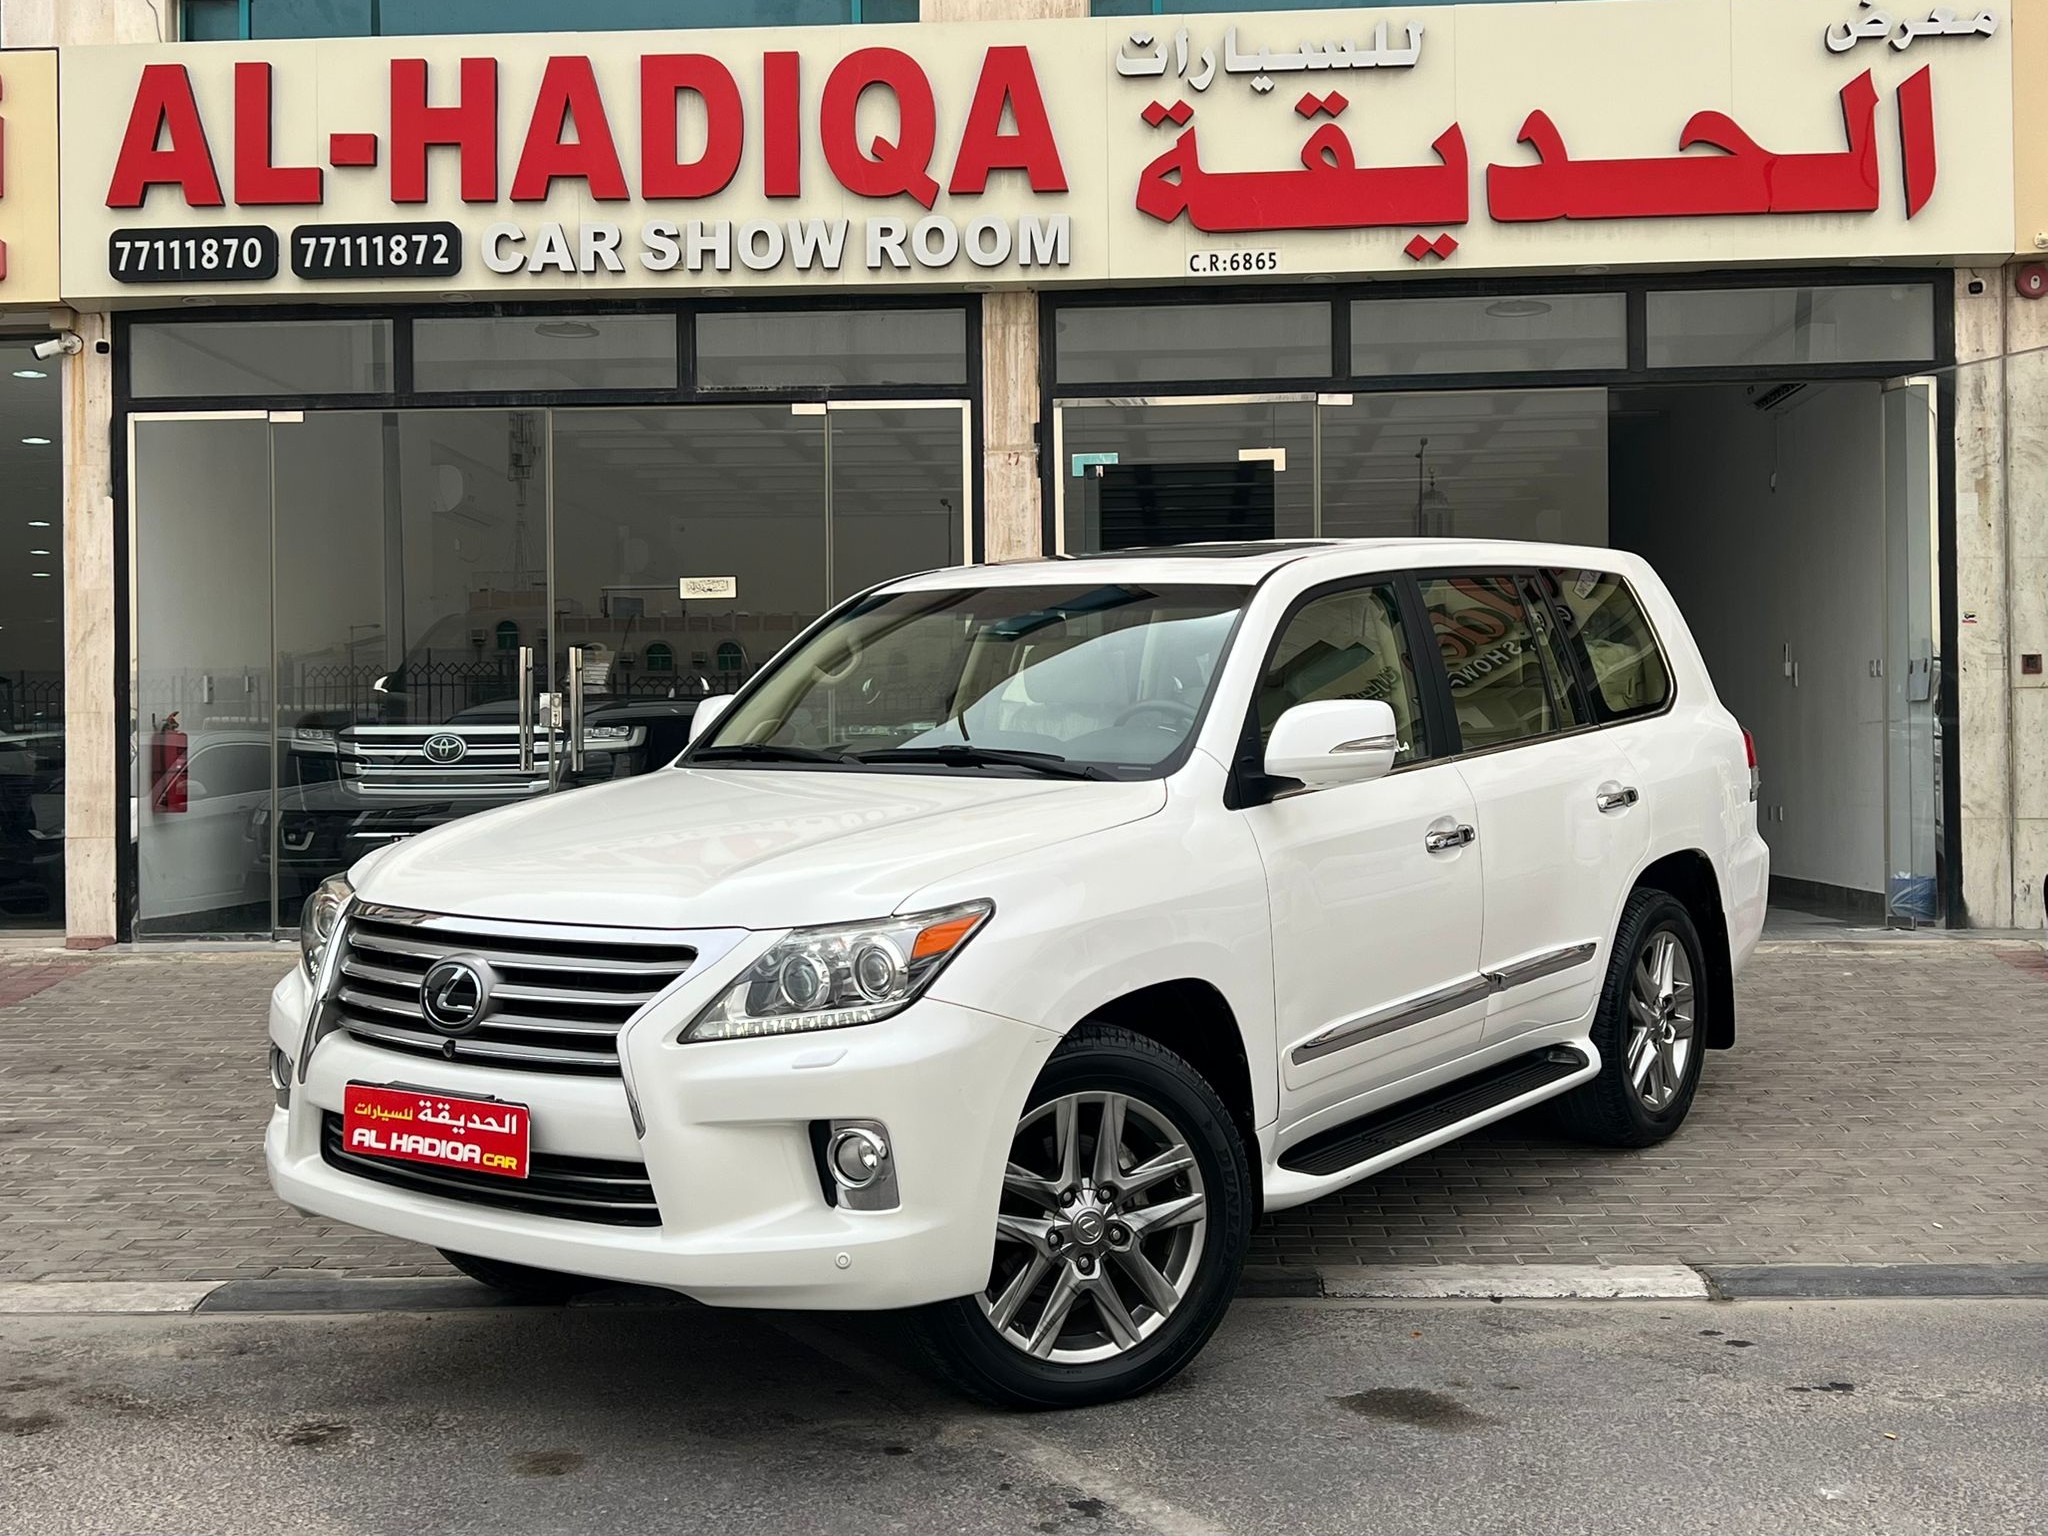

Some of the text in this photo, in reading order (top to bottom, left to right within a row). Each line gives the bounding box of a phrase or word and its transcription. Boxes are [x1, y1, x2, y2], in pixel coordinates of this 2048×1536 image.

[1824, 0, 1999, 54] معرض
[1116, 19, 1424, 93] للسيارات
[105, 46, 1069, 211] AL-HADIQA
[1136, 64, 1936, 262] الحديقة
[115, 233, 449, 271] 77111870 77111872
[481, 214, 1071, 273] CAR SHOW ROOM
[1190, 252, 1277, 272] C.R:6865
[354, 1100, 517, 1135] الحديقة للسيارات
[352, 1128, 517, 1170] AL HADIQA CAR
